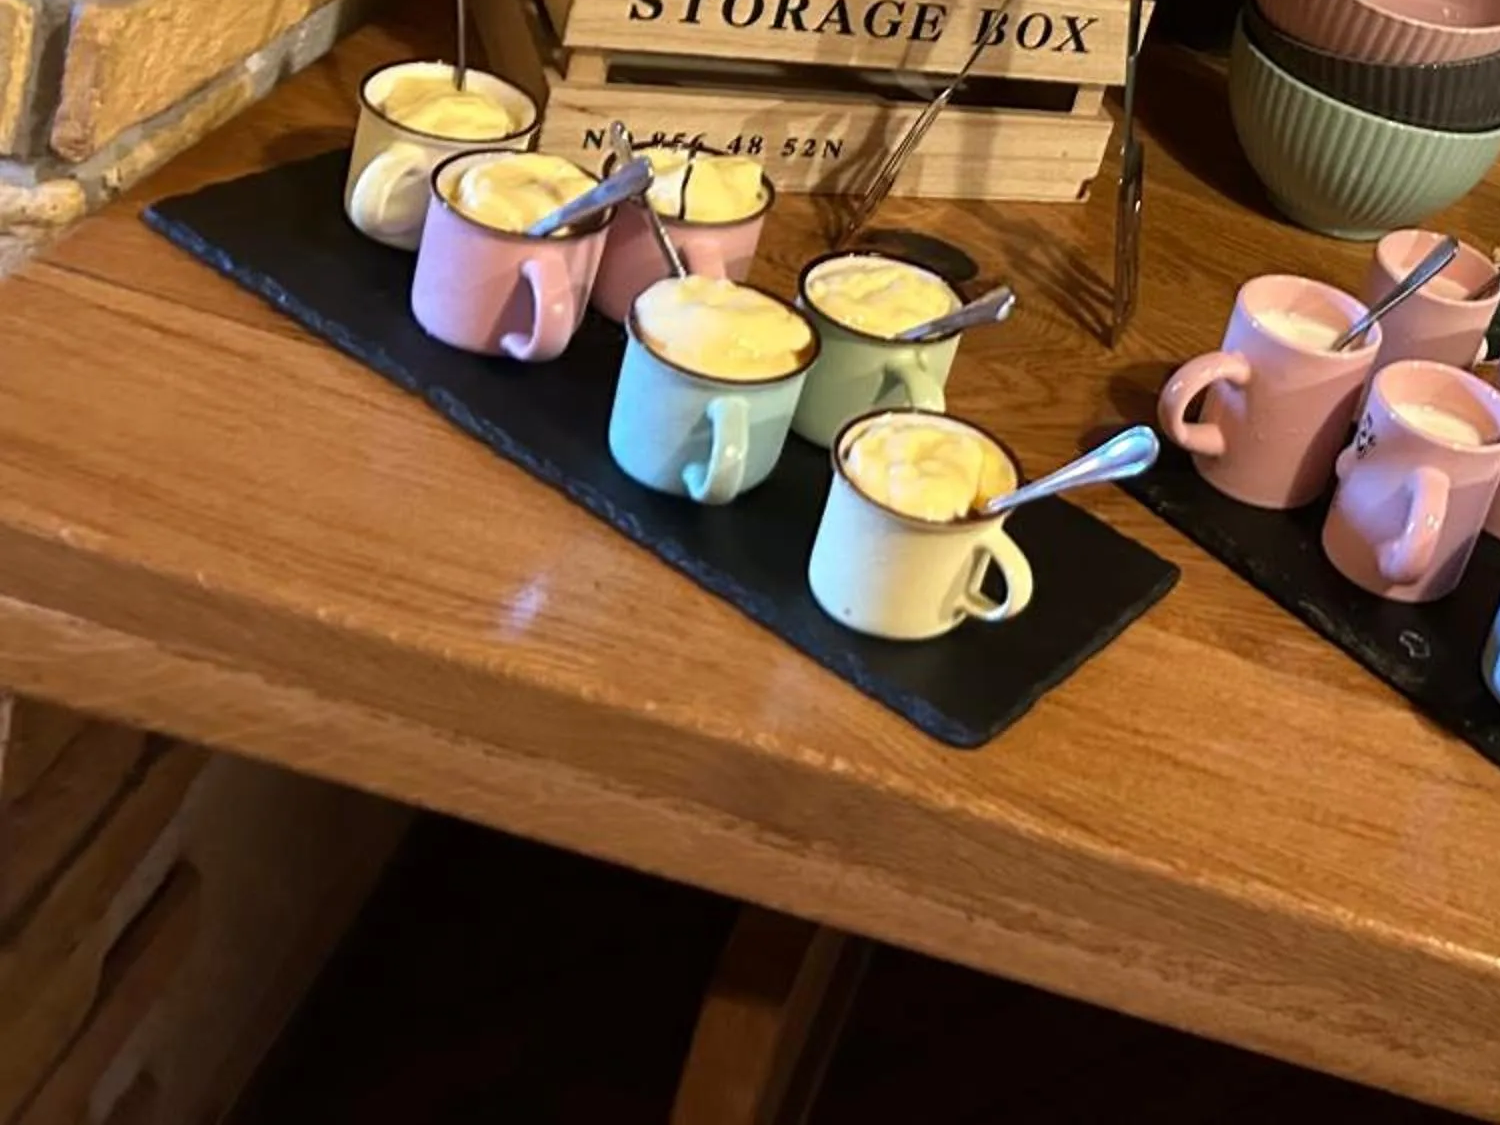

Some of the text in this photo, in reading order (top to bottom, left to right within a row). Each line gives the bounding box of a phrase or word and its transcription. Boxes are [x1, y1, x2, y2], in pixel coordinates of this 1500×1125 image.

[971, 8, 1098, 54] BOX
[727, 134, 764, 156] 48
[780, 137, 845, 159] 52N
